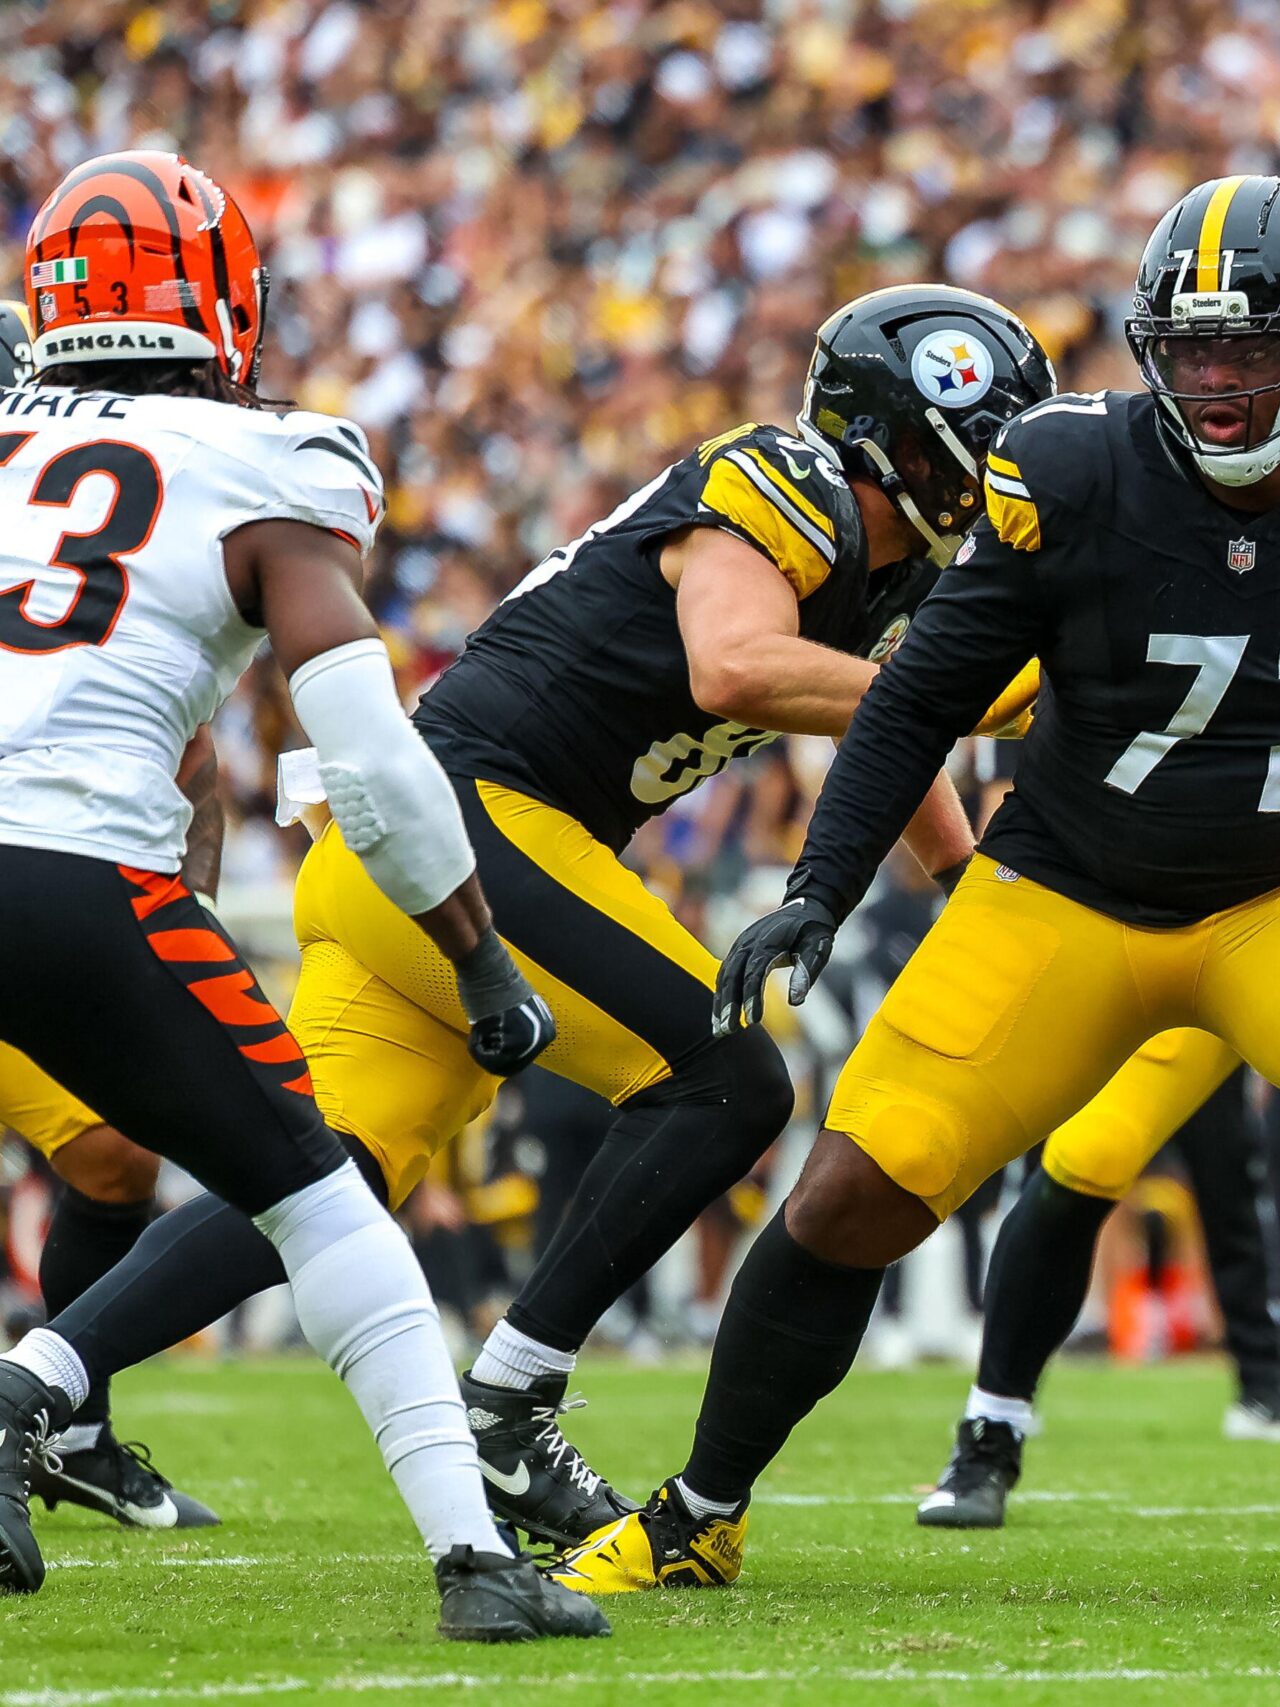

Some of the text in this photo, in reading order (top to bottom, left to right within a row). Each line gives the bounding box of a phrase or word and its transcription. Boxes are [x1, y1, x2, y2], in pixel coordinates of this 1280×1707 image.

[1192, 298, 1221, 308] Steelers
[45, 334, 175, 356] BENGALS
[925, 350, 952, 368] Steelers
[0, 431, 164, 656] 3
